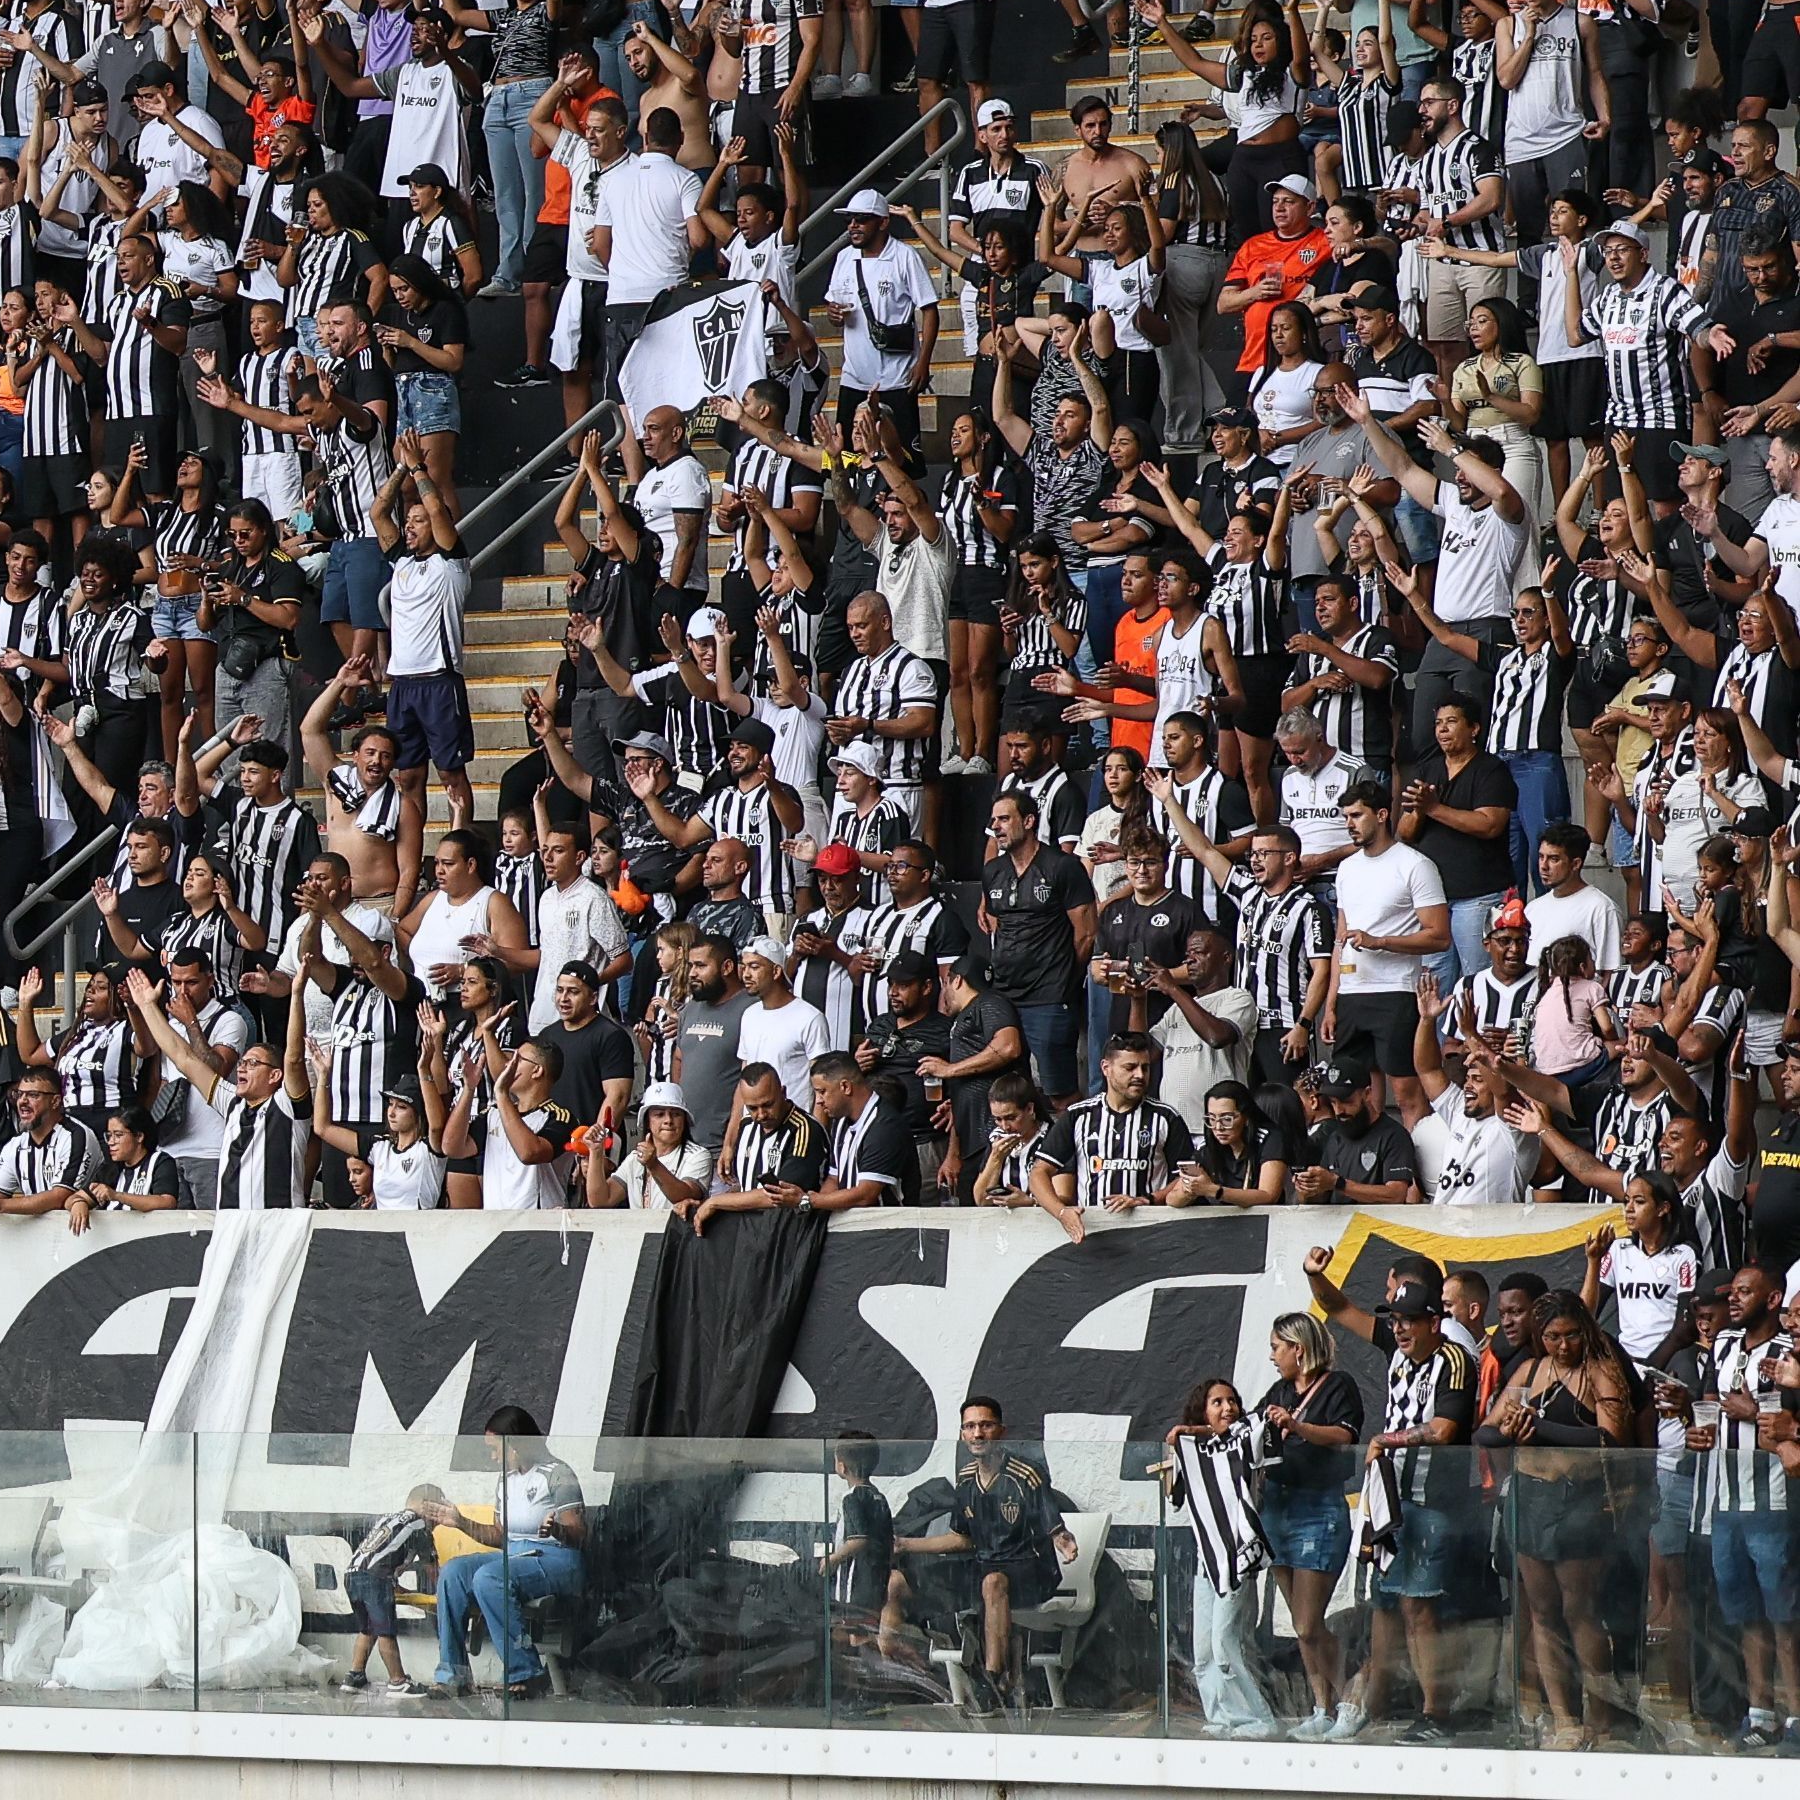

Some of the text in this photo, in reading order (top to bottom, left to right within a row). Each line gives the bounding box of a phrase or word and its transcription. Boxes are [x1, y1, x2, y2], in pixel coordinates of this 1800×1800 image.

[1105, 88, 1119, 106] N
[88, 243, 116, 263] H2
[697, 298, 747, 337] CAM
[1466, 399, 1491, 409] BETA
[1440, 529, 1477, 554] H2bet
[1296, 807, 1339, 819] BETANO
[1671, 808, 1719, 821] BETANO
[237, 843, 273, 869] H2bet
[1311, 918, 1323, 947] MRV
[332, 1023, 375, 1048] H2bet
[59, 1055, 103, 1075] H2bet
[1102, 1157, 1147, 1171] BETANO
[1619, 1282, 1670, 1299] MRV
